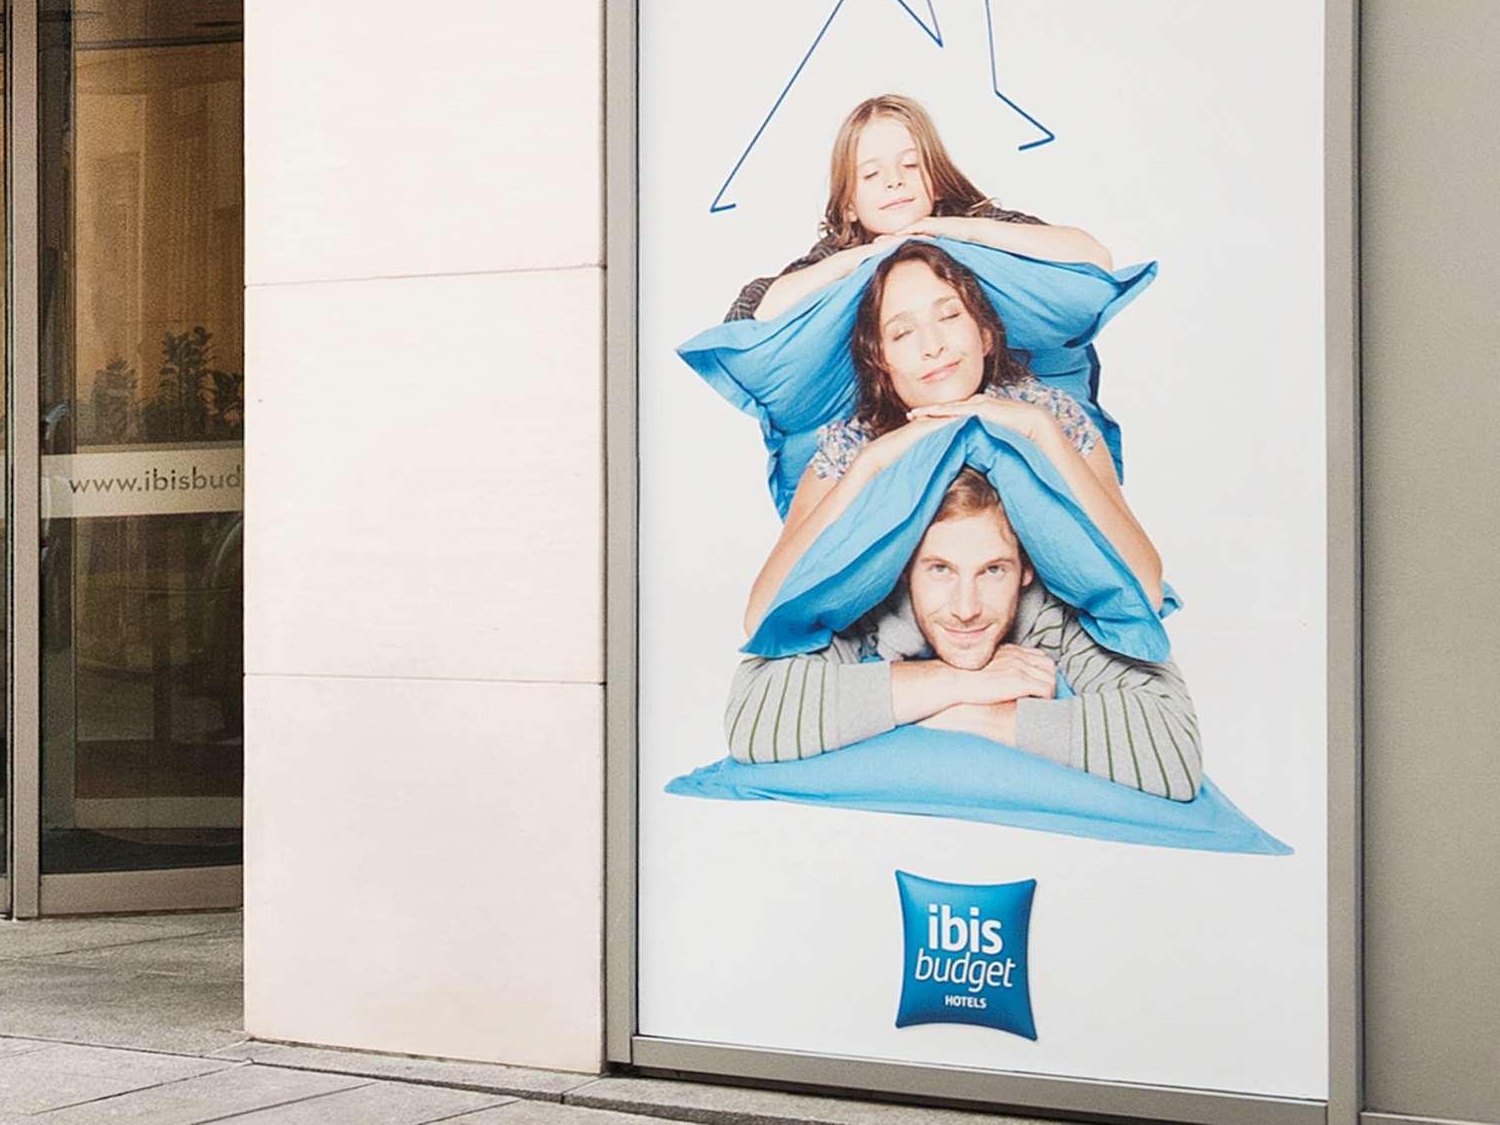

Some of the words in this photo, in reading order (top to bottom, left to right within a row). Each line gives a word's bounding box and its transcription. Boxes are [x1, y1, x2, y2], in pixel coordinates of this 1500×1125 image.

[69, 465, 241, 494] www.ibisbud
[928, 903, 1003, 955] ibis
[914, 947, 1016, 993] budget
[944, 994, 987, 1009] HOTELS
